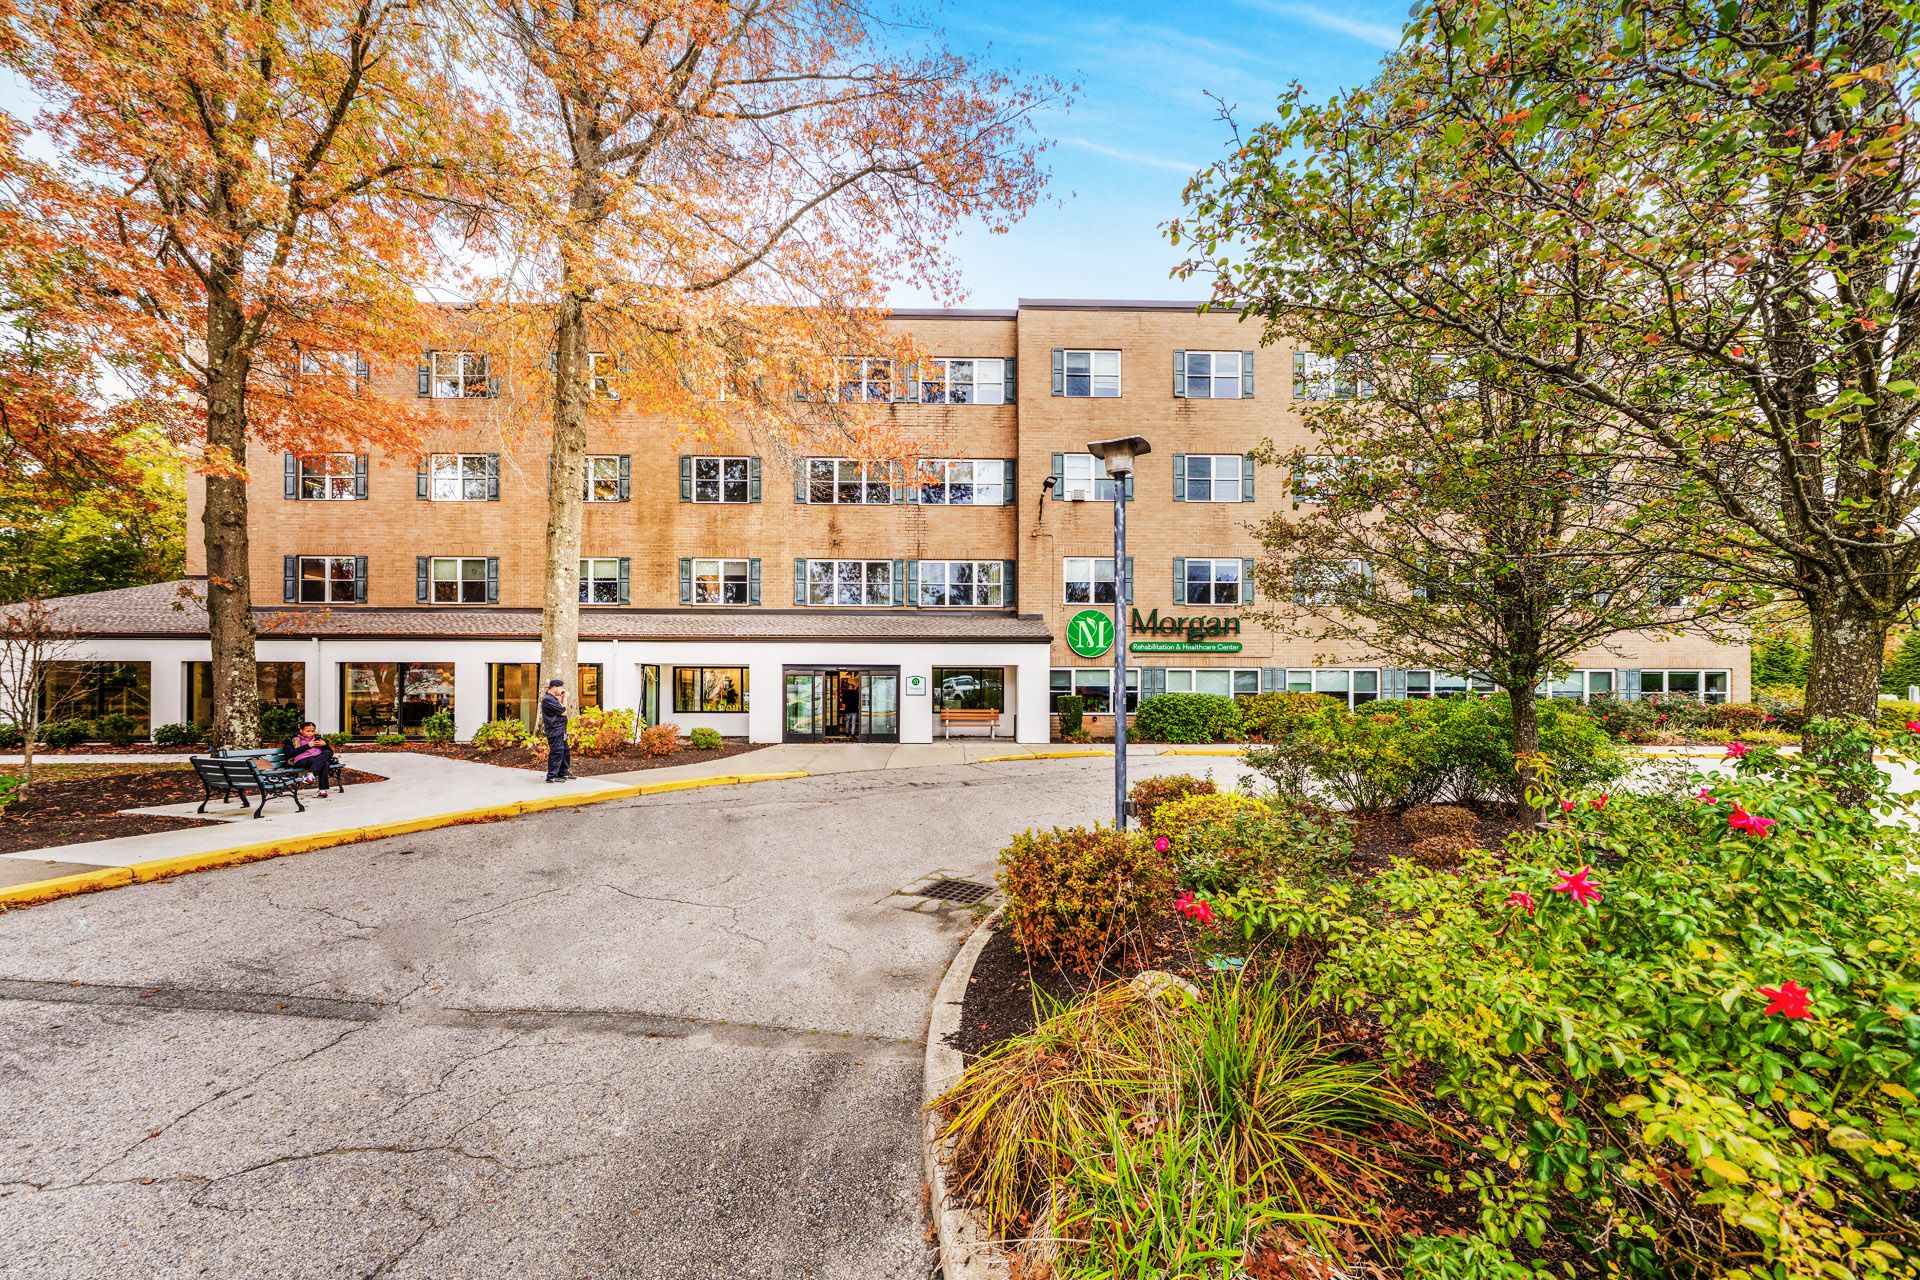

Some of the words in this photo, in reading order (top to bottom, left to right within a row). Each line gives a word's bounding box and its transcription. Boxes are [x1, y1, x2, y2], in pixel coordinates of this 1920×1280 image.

[1131, 608, 1241, 641] Morgan
[1132, 643, 1175, 651] Rehabilitation
[1175, 643, 1181, 651] &
[1182, 643, 1216, 651] Healthcare
[1217, 643, 1240, 651] Center
